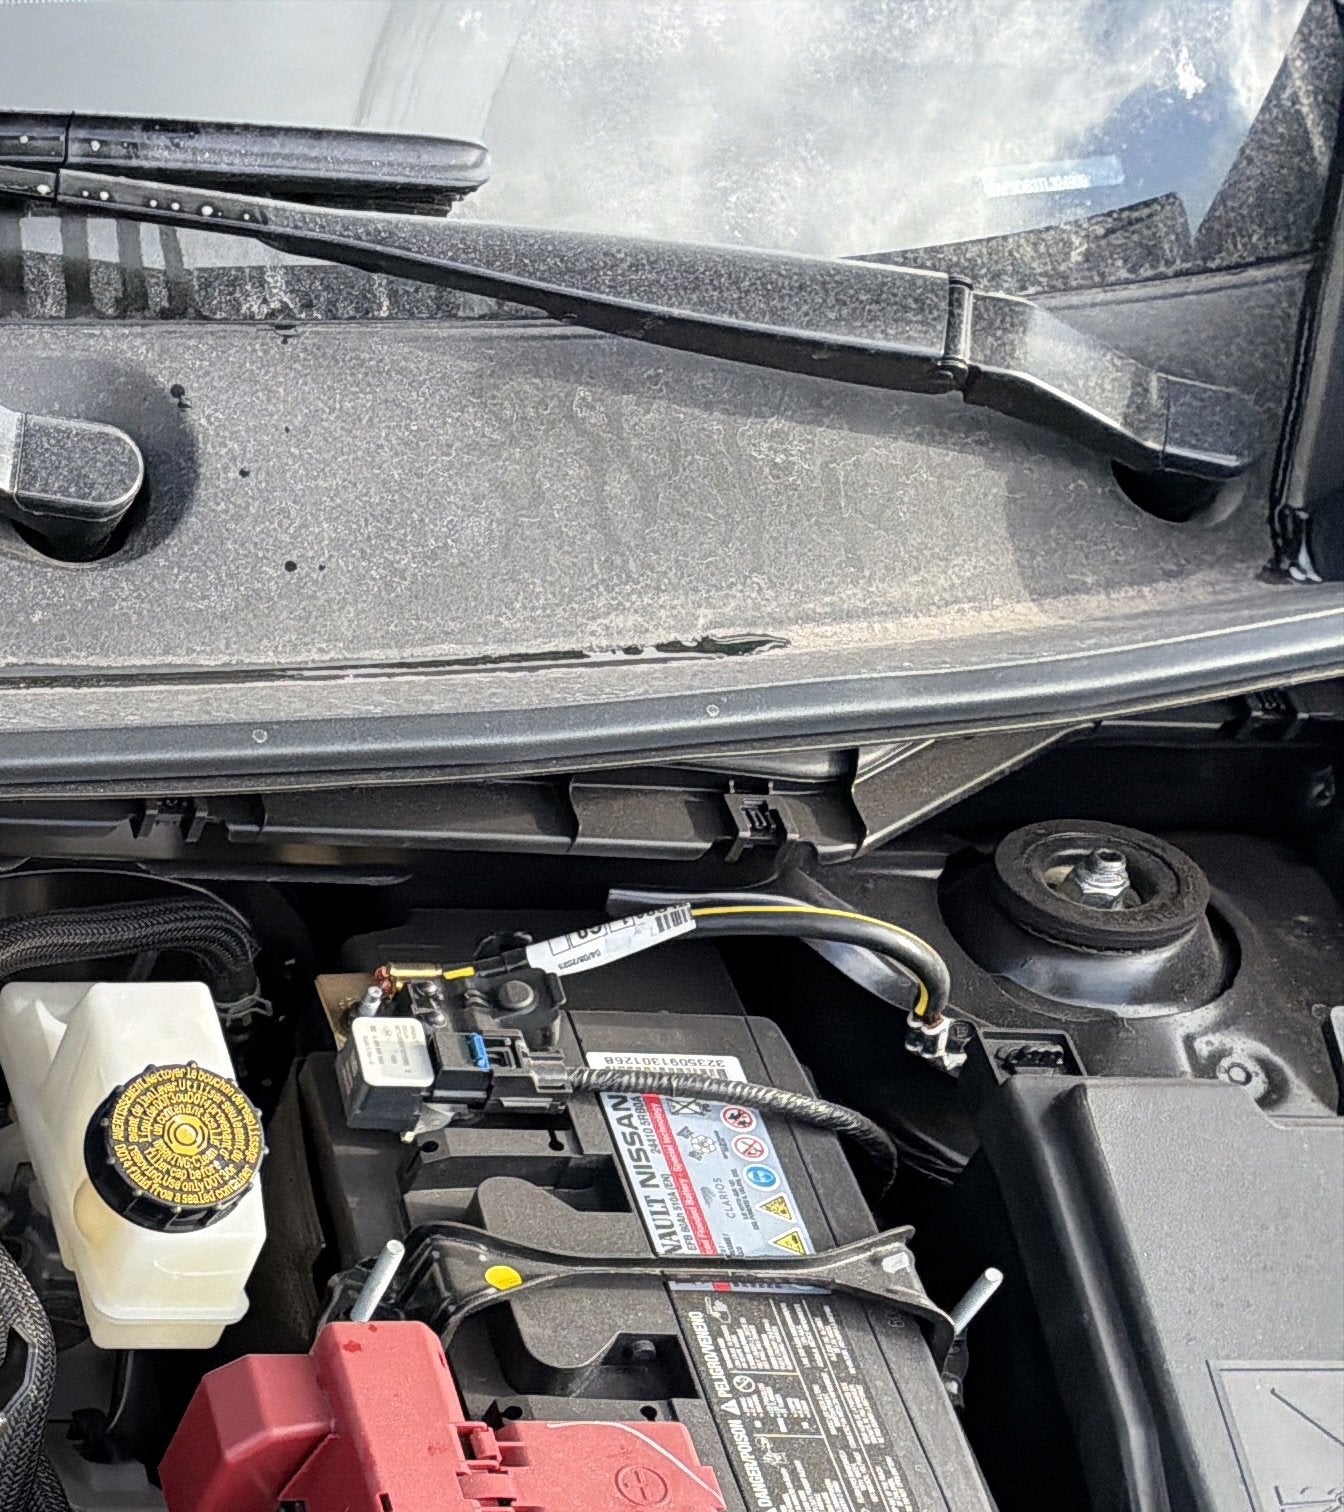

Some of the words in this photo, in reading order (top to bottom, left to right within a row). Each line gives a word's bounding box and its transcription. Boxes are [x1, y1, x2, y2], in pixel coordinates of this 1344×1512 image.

[607, 1094, 660, 1189] NISSAN
[167, 1167, 186, 1179] cap
[150, 1184, 172, 1200] from
[182, 1188, 214, 1205] sealed
[713, 1177, 736, 1219] CLARIOS
[683, 1233, 697, 1251] EFB
[688, 1311, 733, 1398] PELIGRO/VENENO
[727, 1419, 773, 1508] DANGER/POISON
